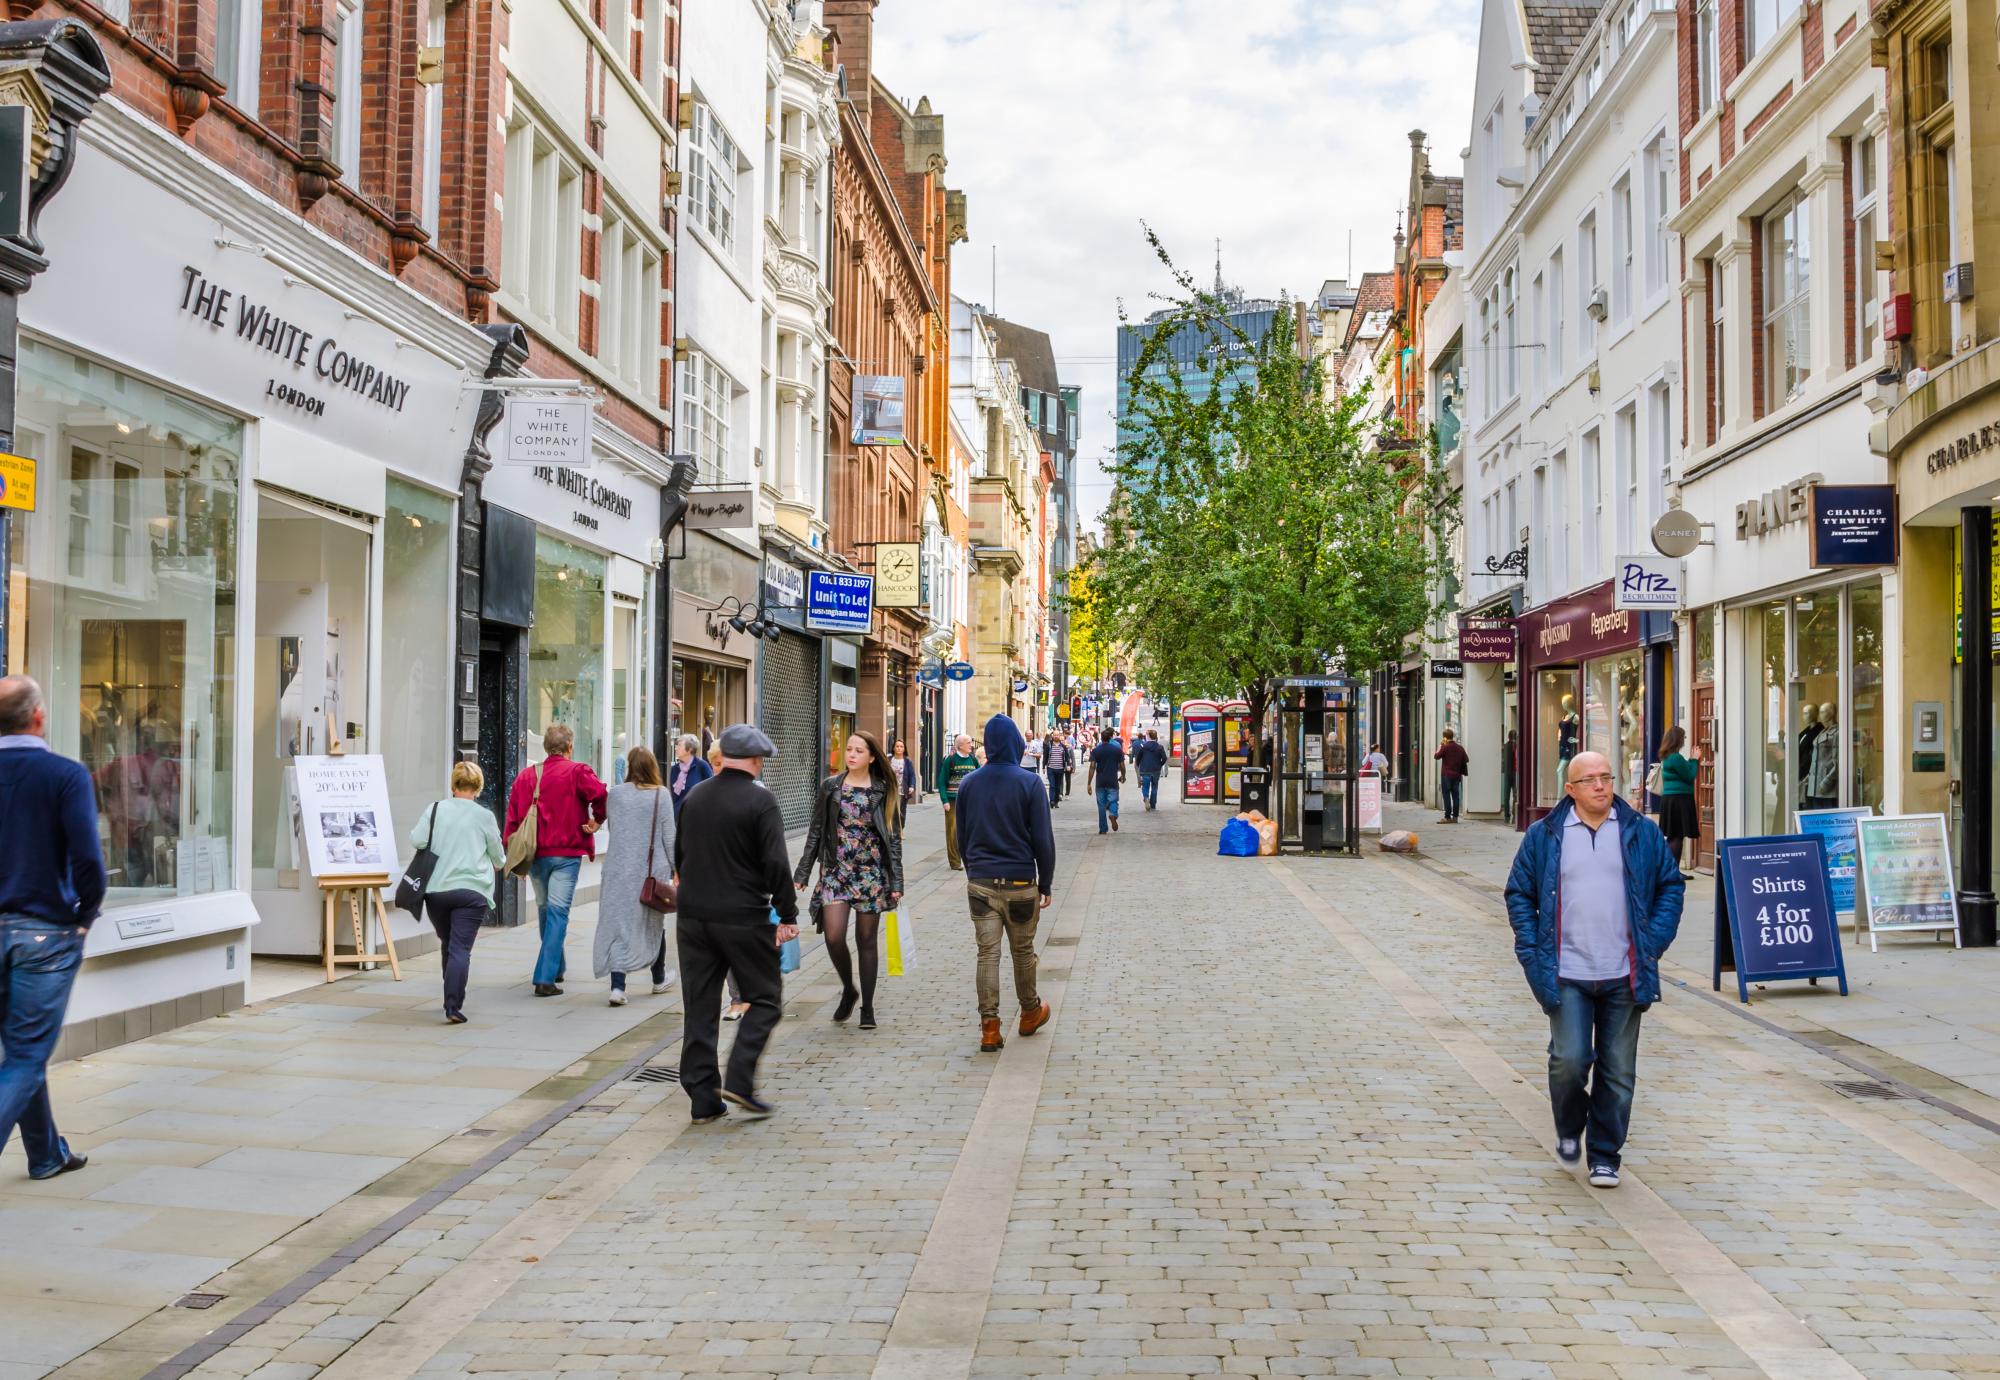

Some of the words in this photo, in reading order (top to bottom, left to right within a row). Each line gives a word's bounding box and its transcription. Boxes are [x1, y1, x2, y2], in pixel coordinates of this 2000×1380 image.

[181, 265, 232, 327] THE
[237, 295, 312, 366] WHITE
[316, 338, 411, 412] COMPANY
[266, 379, 326, 416] LONDON
[537, 408, 560, 418] THE
[527, 422, 569, 432] WHITE
[515, 436, 579, 446] COMPANY
[20, 462, 33, 473] Zone
[557, 467, 588, 499] WHITE
[590, 478, 632, 520] COMPANY
[573, 510, 599, 531] LONDON
[838, 577, 852, 587] 833
[853, 579, 870, 588] 1197
[877, 584, 918, 592] HANCOCKS
[815, 590, 837, 603] Unit
[839, 593, 851, 604] To
[852, 595, 867, 607] Let
[849, 610, 868, 619] Moore
[1540, 613, 1570, 656] BRAVISSIMO
[1591, 593, 1628, 640] Pepperberry
[1463, 633, 1511, 646] BRAVISSIMO
[1464, 645, 1510, 659] Pepperberry
[309, 770, 336, 778] HOME
[340, 769, 369, 777] EVENT
[315, 782, 339, 792] 20%
[341, 781, 367, 791] OFF
[1752, 876, 1806, 894] Shirts
[1756, 906, 1771, 925] 4
[1775, 903, 1811, 924] for
[1760, 924, 1813, 946] £100
